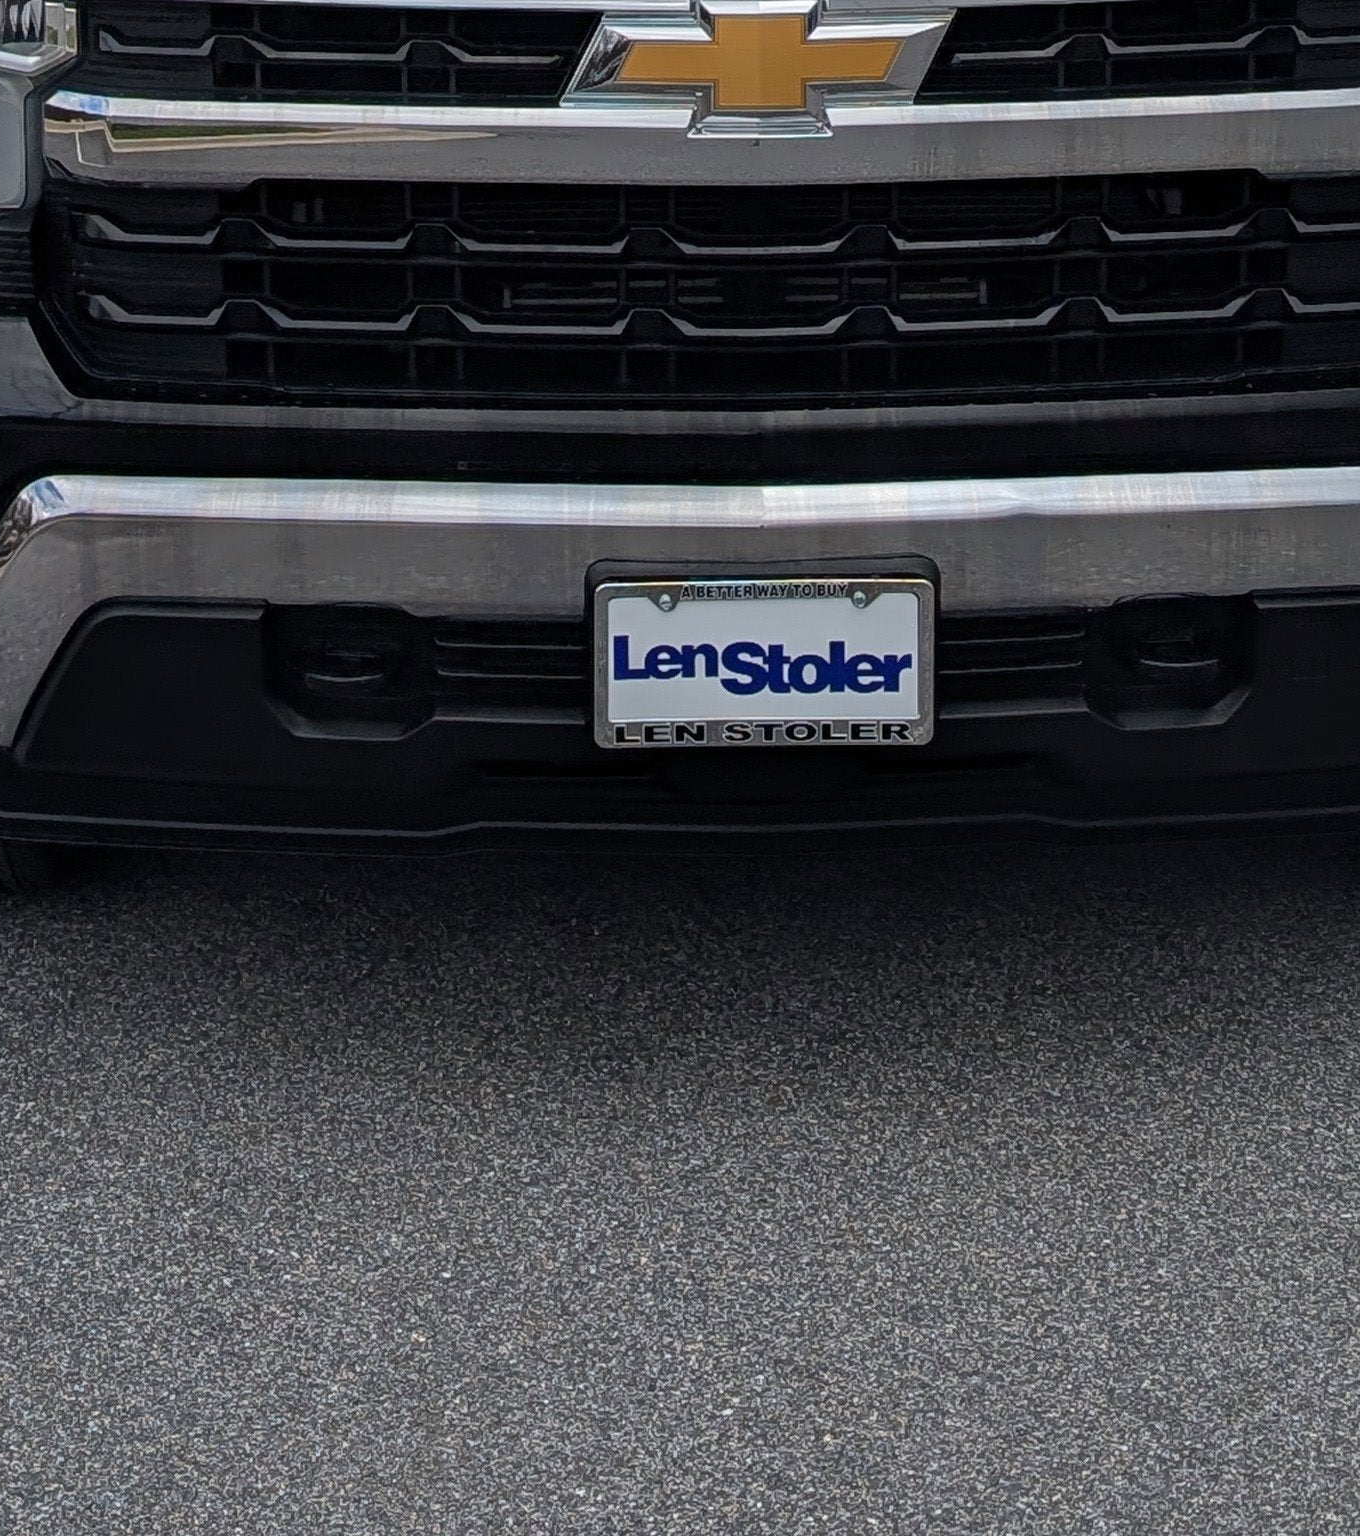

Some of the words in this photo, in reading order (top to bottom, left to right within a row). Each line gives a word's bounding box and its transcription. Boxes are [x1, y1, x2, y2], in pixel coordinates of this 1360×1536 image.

[680, 583, 693, 600] A
[695, 584, 753, 600] BETTER
[756, 583, 790, 599] WAY
[791, 583, 813, 599] TO
[816, 582, 849, 598] BUY
[613, 722, 708, 746] LEN
[722, 720, 916, 745] STOLER
